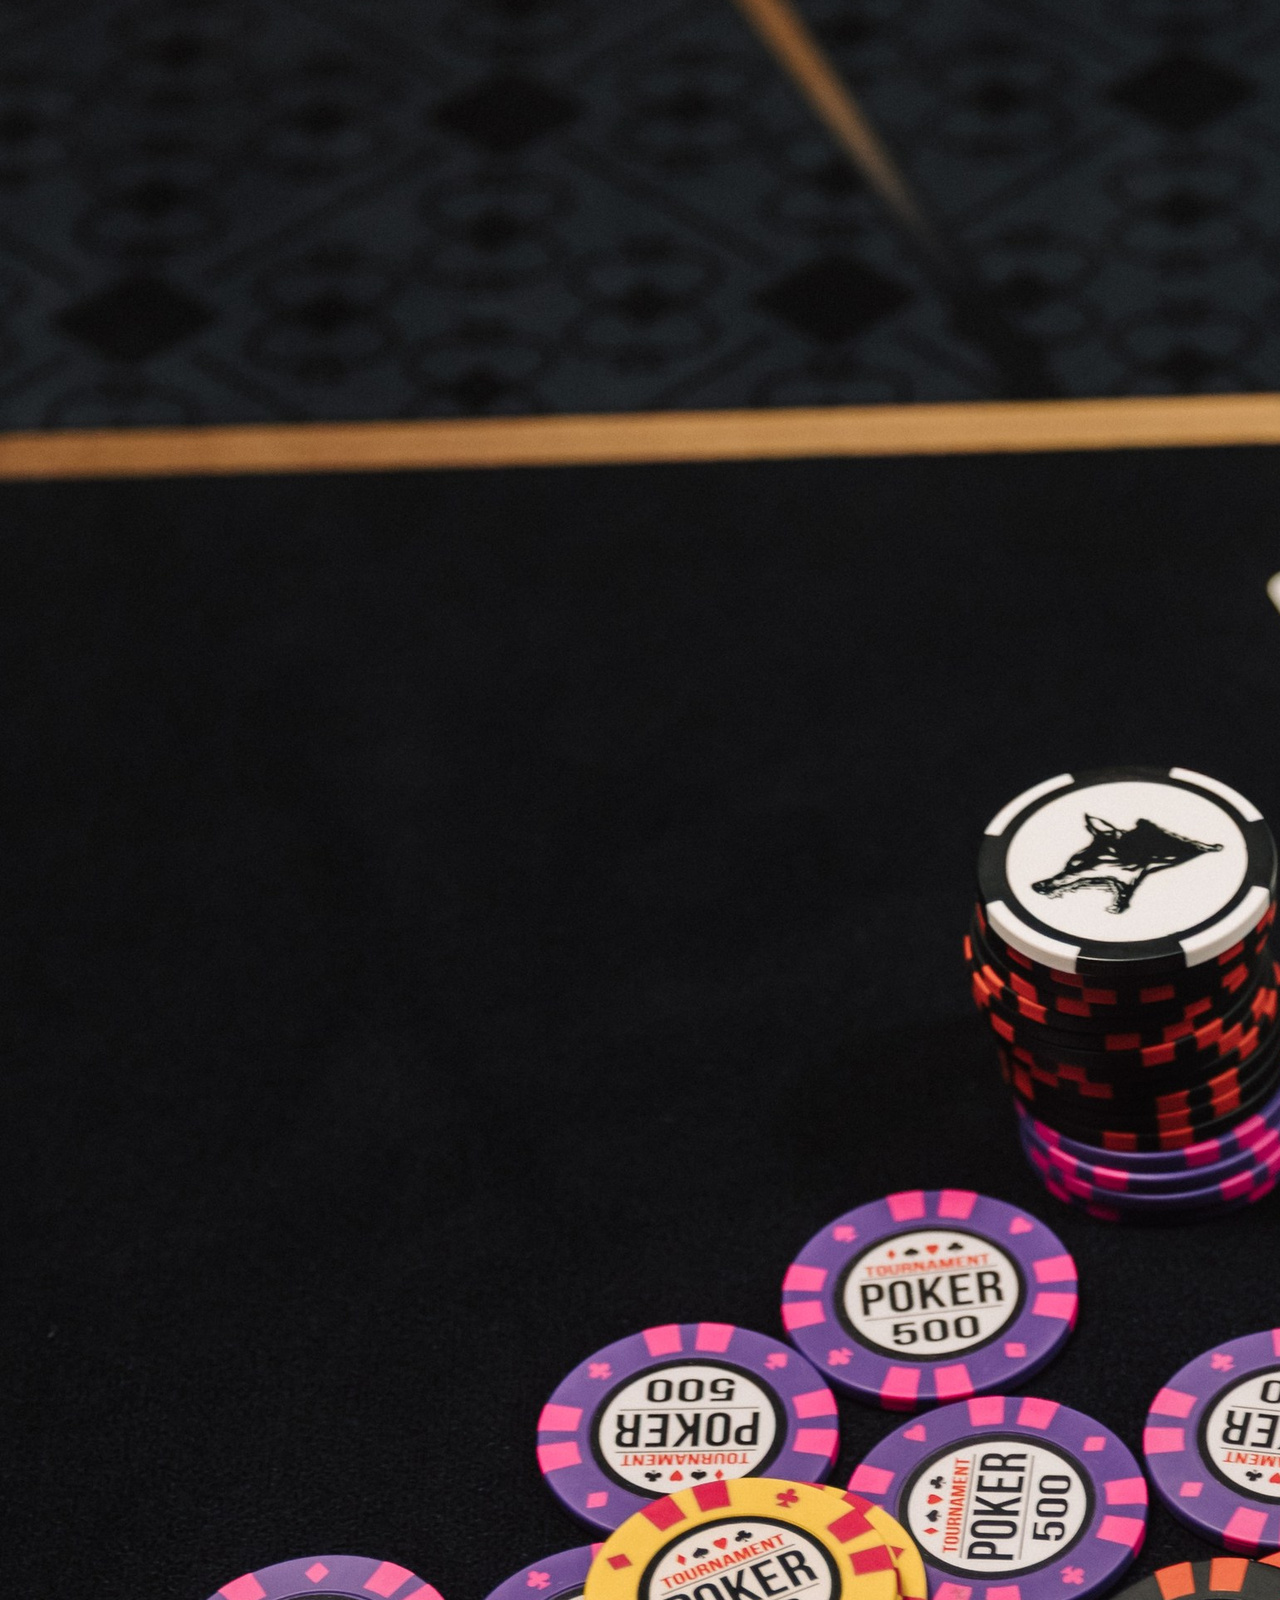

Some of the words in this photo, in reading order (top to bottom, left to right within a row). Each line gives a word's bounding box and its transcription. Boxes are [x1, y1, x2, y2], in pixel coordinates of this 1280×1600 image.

[865, 1253, 990, 1278] TOURNAMENT
[860, 1270, 1004, 1317] POKER
[892, 1314, 981, 1346] 500
[646, 1377, 735, 1403] 500
[615, 1411, 760, 1449] POKER
[620, 1450, 750, 1467] TOURNAMENT
[942, 1457, 970, 1553] TOURNAMENT
[967, 1452, 1028, 1561] POKER
[1032, 1473, 1073, 1542] 500
[661, 1533, 785, 1590] TOURNAMENT
